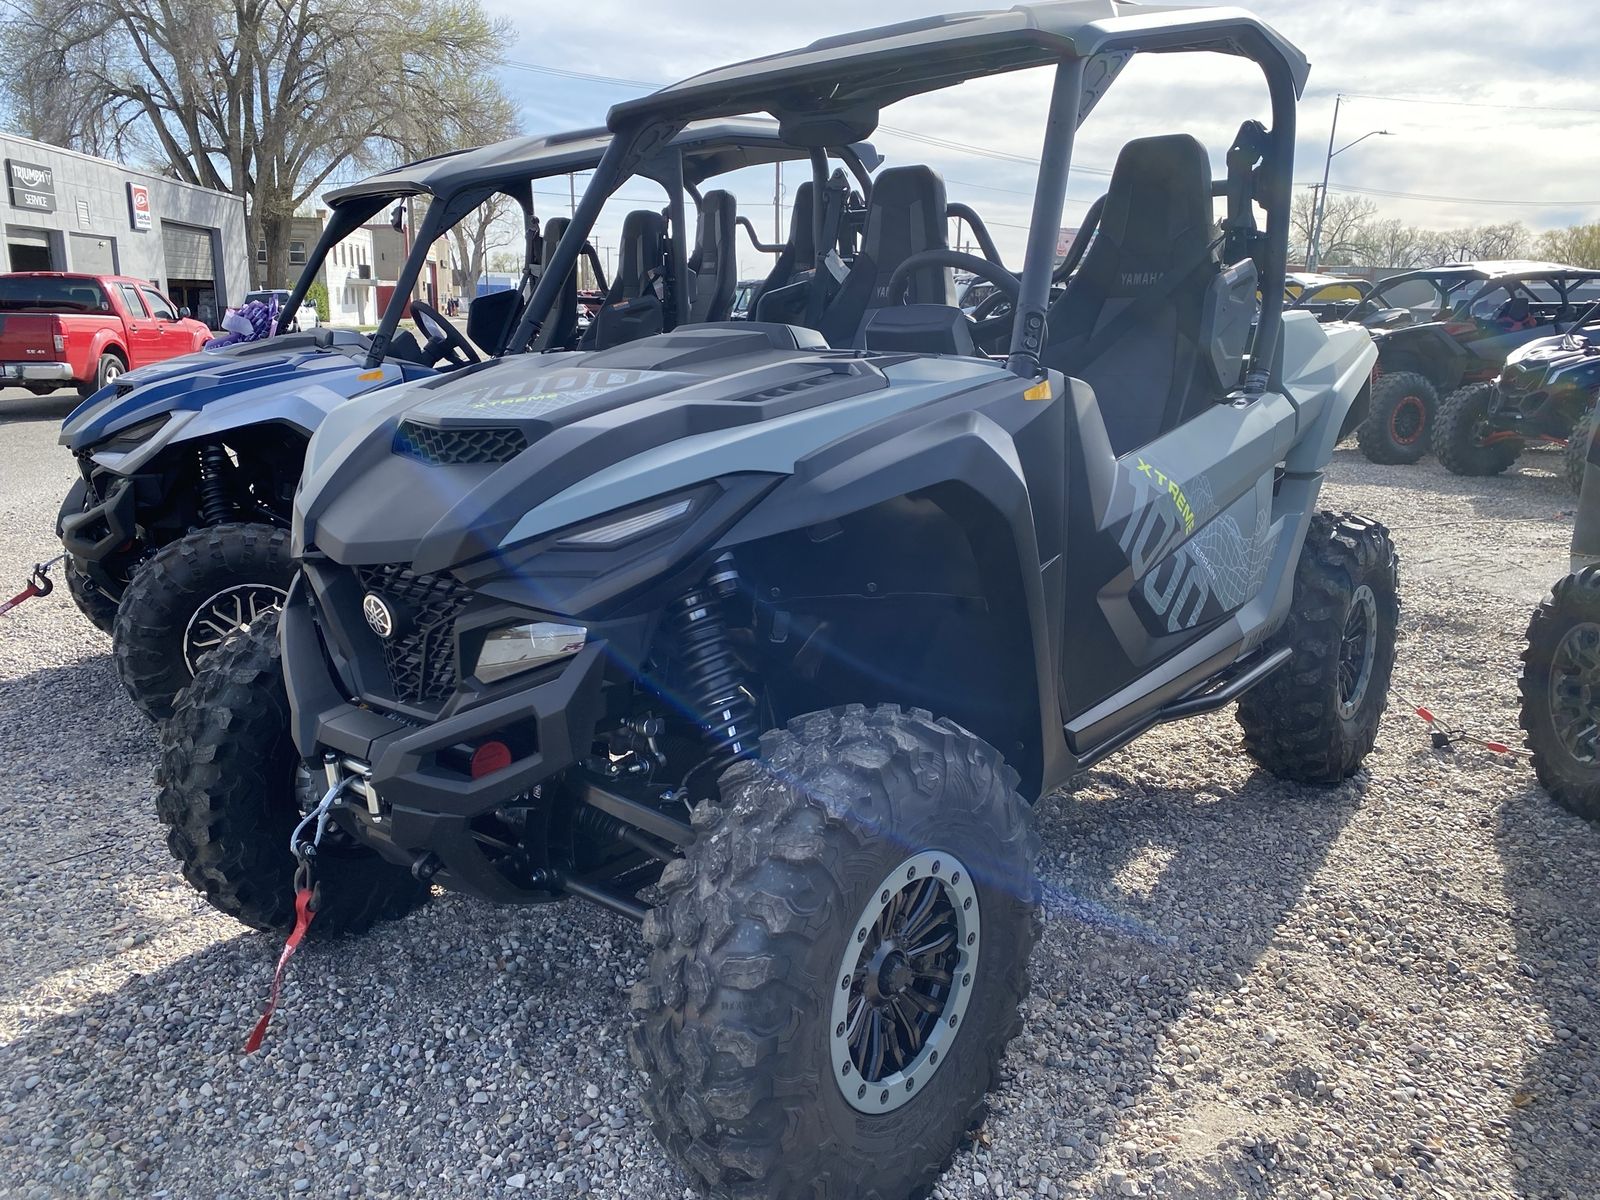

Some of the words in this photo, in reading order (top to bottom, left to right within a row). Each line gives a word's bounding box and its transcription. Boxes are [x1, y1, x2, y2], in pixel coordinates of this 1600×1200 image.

[12, 165, 46, 186] TRIUMPH
[24, 193, 48, 207] SERVICE
[473, 391, 560, 409] XTREME
[1137, 457, 1196, 536] XTREME
[1118, 465, 1209, 632] 1000
[1191, 540, 1217, 580] TERRAIN
